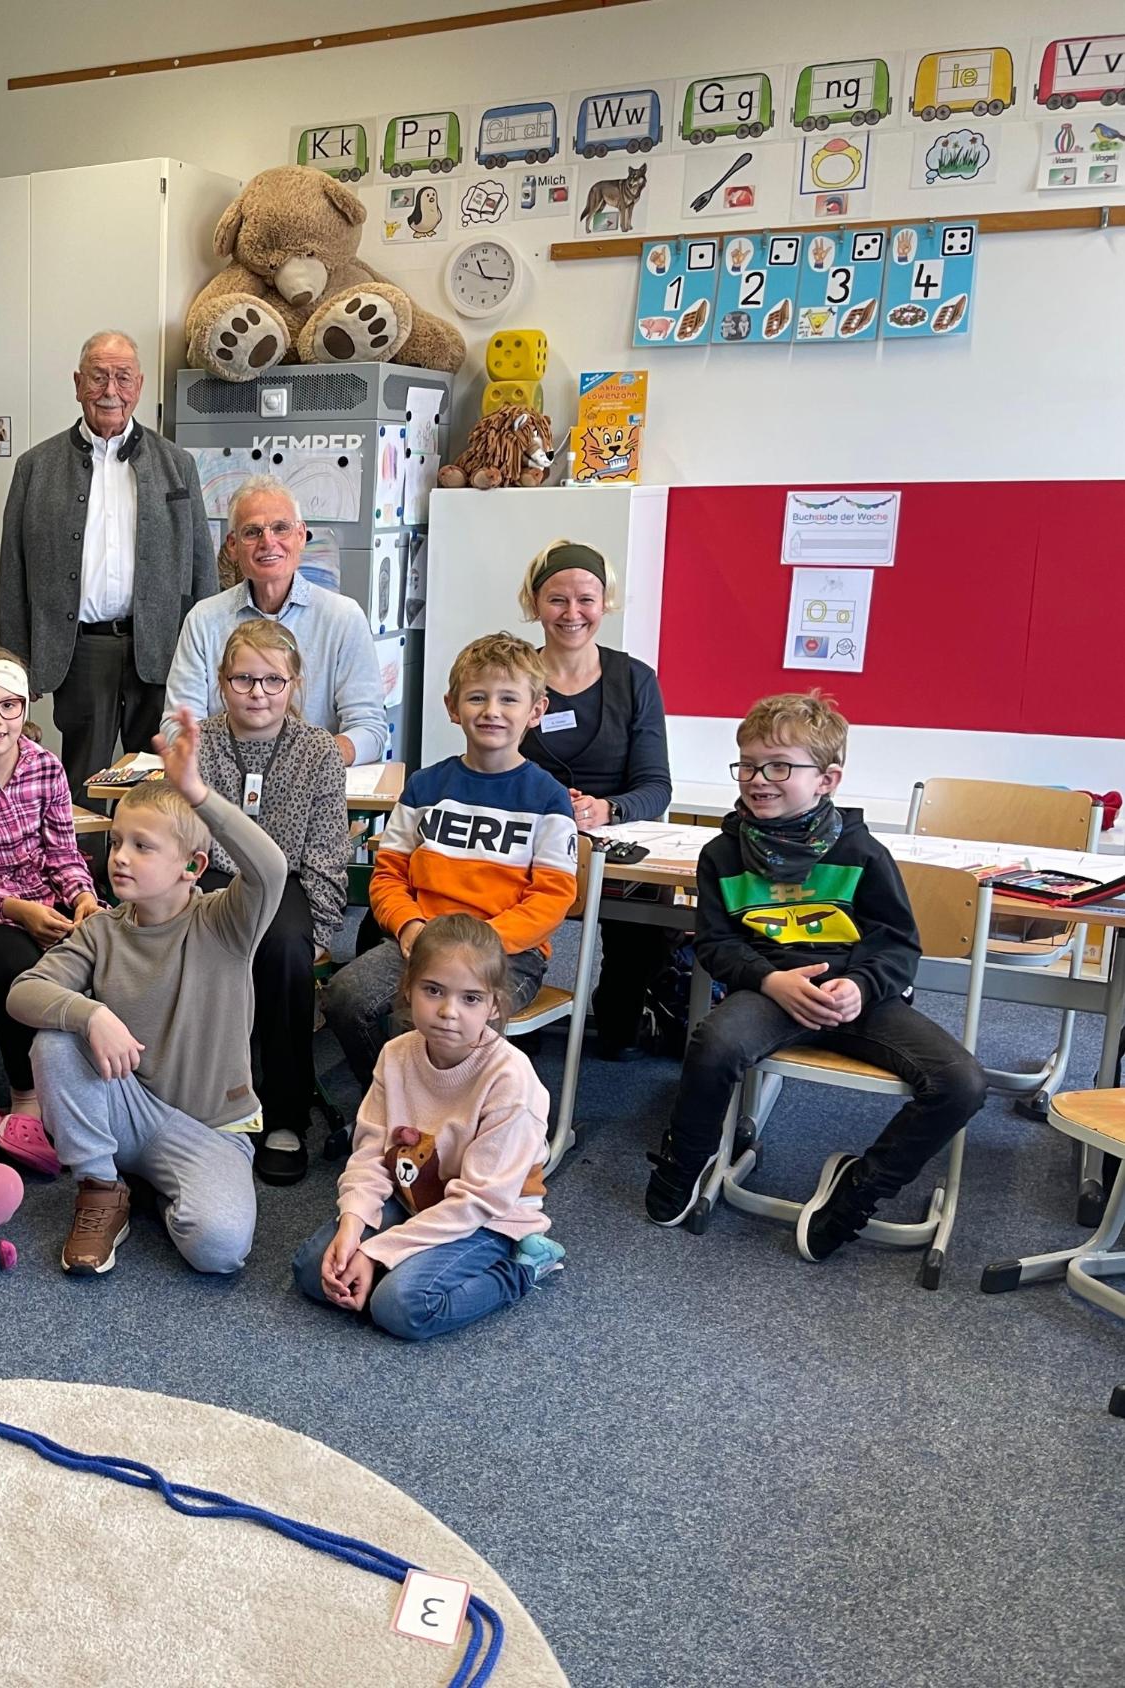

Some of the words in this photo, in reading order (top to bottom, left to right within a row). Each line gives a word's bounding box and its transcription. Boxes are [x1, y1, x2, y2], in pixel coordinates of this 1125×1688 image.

[826, 76, 860, 108] ng
[952, 64, 978, 88] ie
[537, 174, 566, 187] Milch
[668, 276, 682, 309] 1
[741, 271, 765, 306] 2
[826, 267, 852, 304] 3
[913, 263, 940, 298] 4
[792, 512, 838, 521] Buchstabe
[840, 513, 854, 521] der
[857, 513, 888, 521] Woche
[418, 808, 532, 855] NERF
[420, 1597, 446, 1627] 3
